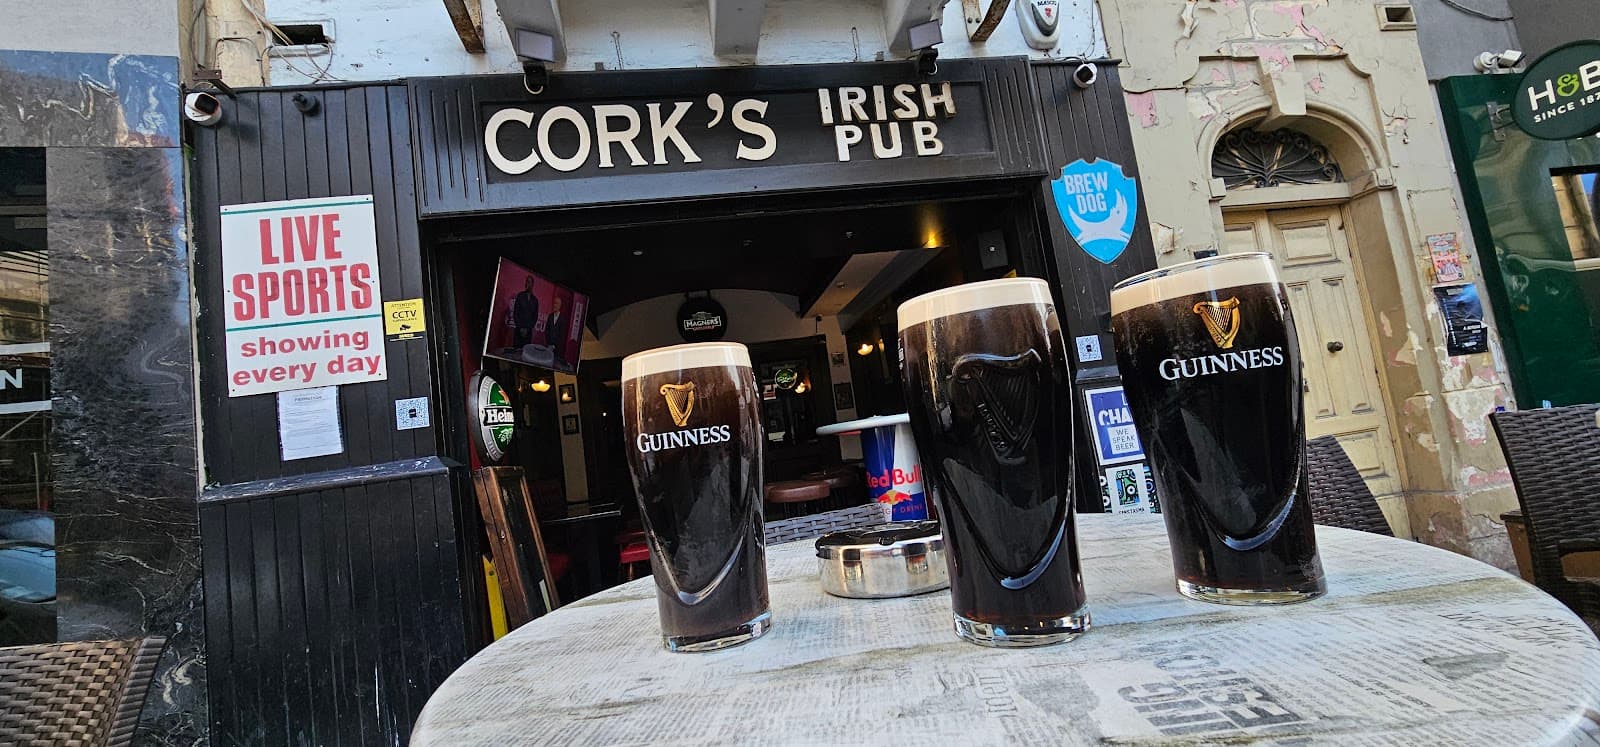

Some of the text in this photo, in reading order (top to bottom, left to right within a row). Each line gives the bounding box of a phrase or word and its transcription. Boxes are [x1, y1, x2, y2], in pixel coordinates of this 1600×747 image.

[818, 80, 957, 126] IRISH
[1533, 101, 1576, 123] SINCE
[484, 92, 777, 175] CORK'S
[834, 120, 944, 162] PUB
[1063, 171, 1108, 195] BREW
[1075, 192, 1108, 215] DOG
[259, 213, 343, 265] LIVE
[232, 262, 372, 322] SPORTS
[392, 309, 417, 319] CCTV
[685, 318, 719, 328] MAGNERS
[240, 330, 369, 358] showing
[232, 354, 381, 386] every day
[1158, 346, 1284, 381] GUINNESS
[636, 425, 731, 453] GUINNESS
[1112, 435, 1135, 444] SPEAK
[1115, 428, 1129, 436] WE
[1115, 442, 1135, 451] BEER
[866, 463, 922, 488] Red Bull
